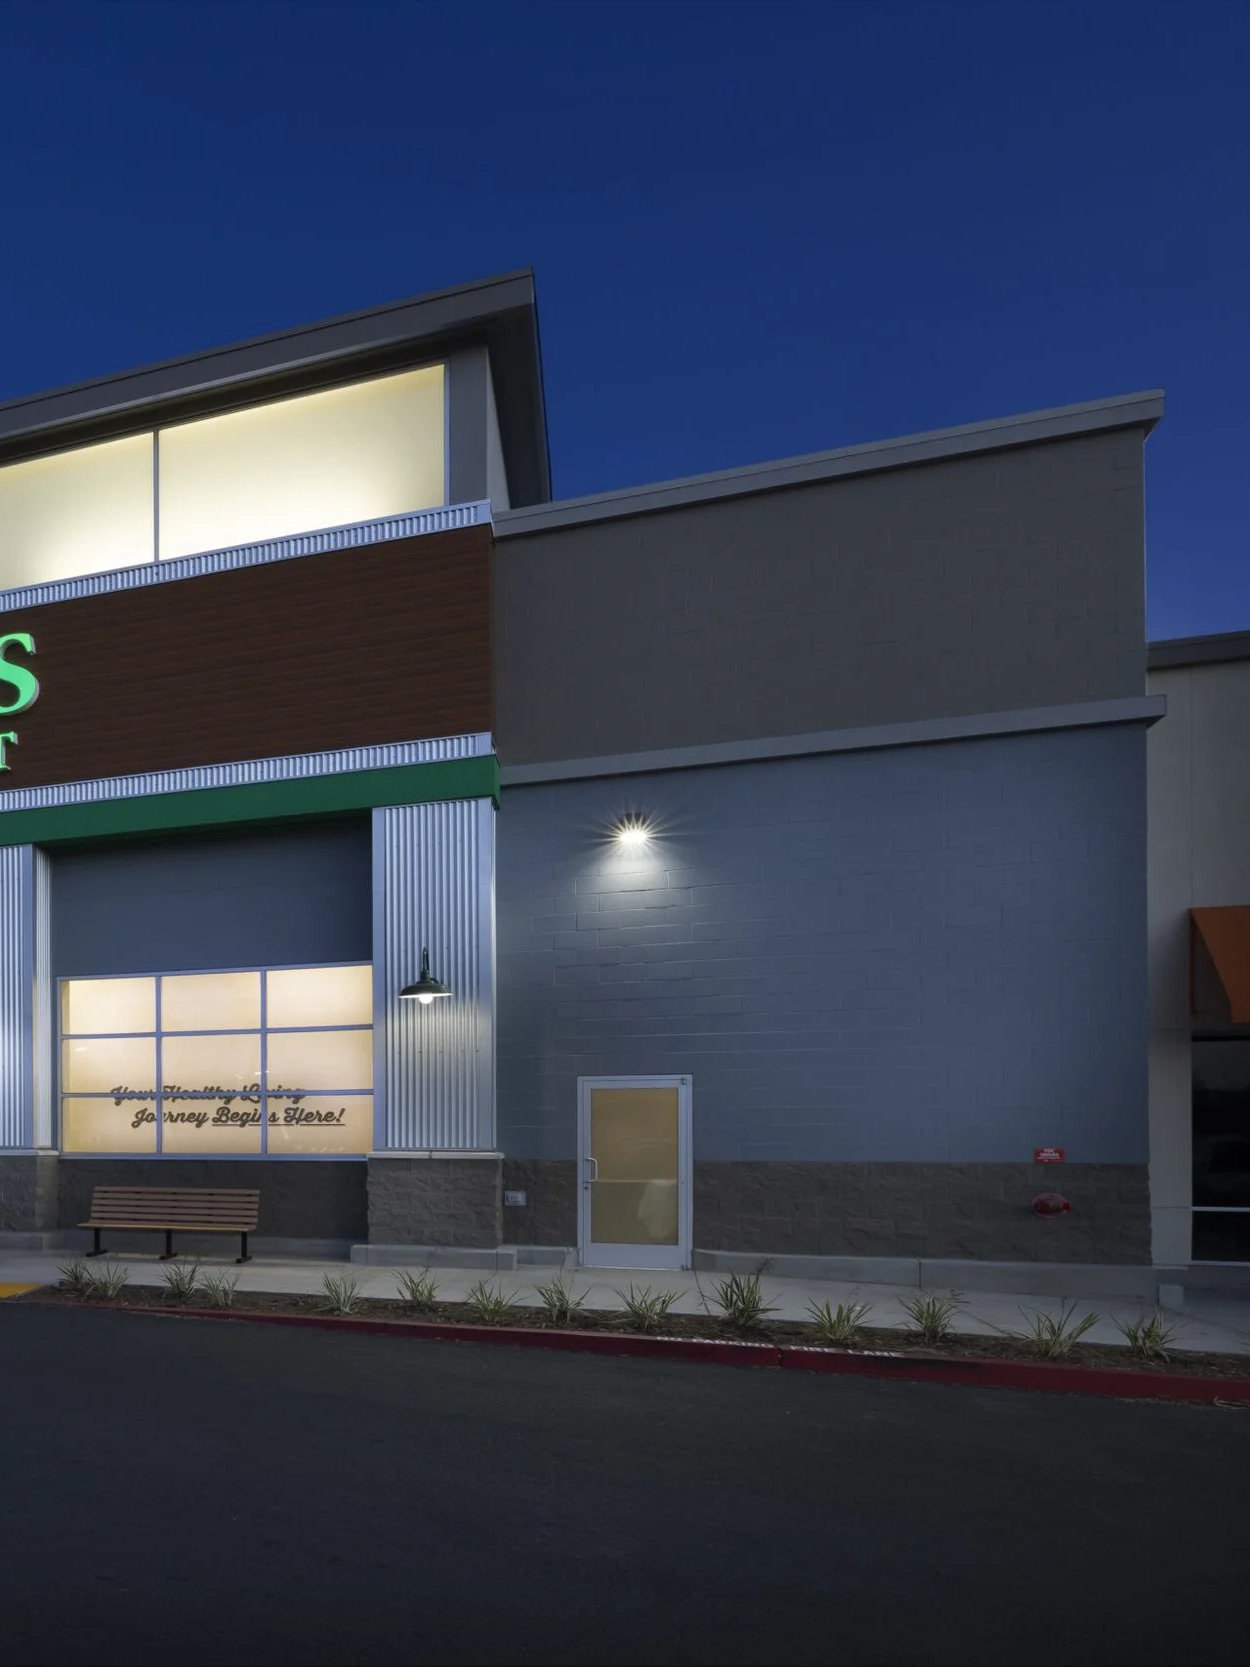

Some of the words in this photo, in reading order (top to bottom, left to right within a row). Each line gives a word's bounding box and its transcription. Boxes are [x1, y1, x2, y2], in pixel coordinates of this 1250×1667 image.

[161, 1084, 236, 1105] Healthy
[240, 1082, 306, 1104] Lving
[283, 1106, 345, 1125] Here!
